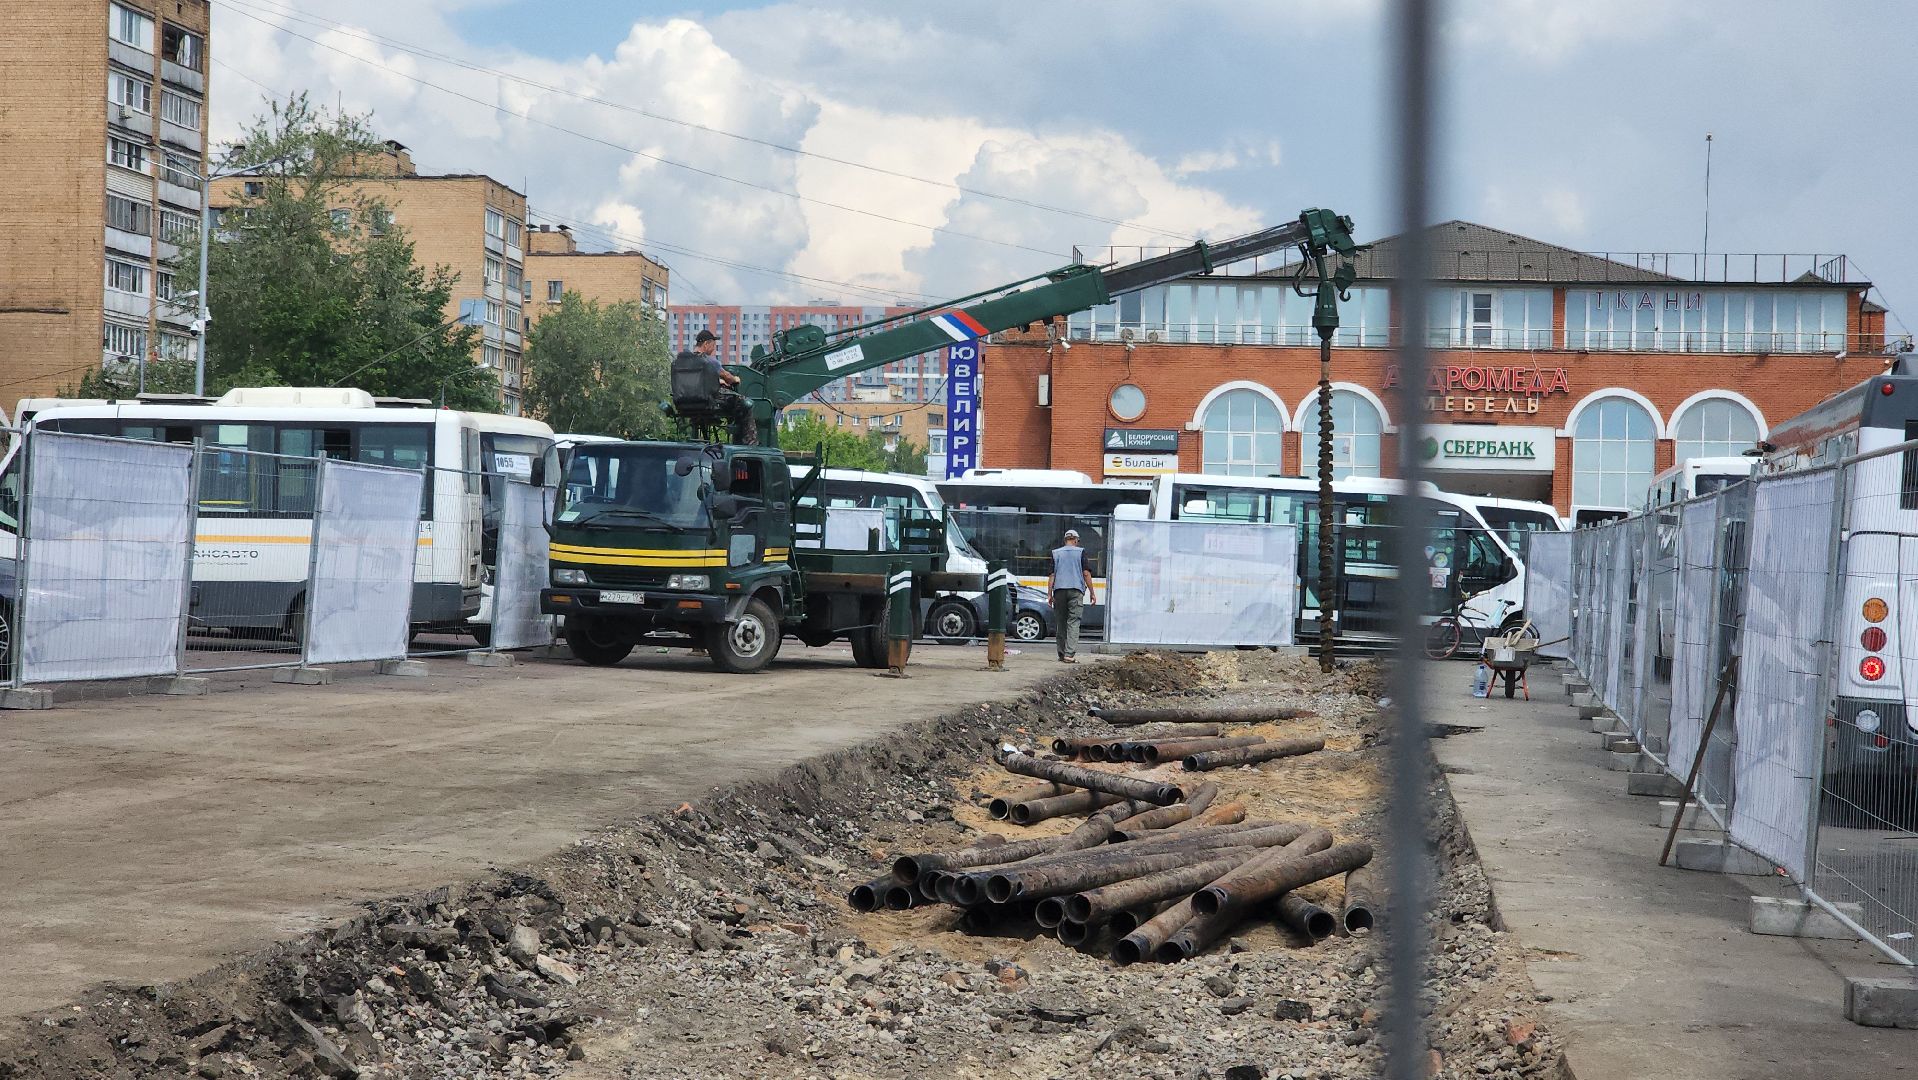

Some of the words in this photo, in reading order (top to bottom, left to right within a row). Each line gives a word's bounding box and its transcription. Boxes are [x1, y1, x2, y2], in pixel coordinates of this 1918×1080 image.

[1596, 289, 1701, 311] ТКАНИ
[1382, 364, 1569, 397] АДРОМЕДА
[949, 346, 975, 479] ЮВЕЛИРН
[1443, 439, 1535, 456] СБЕРБАНК
[1125, 457, 1164, 468] Билайн
